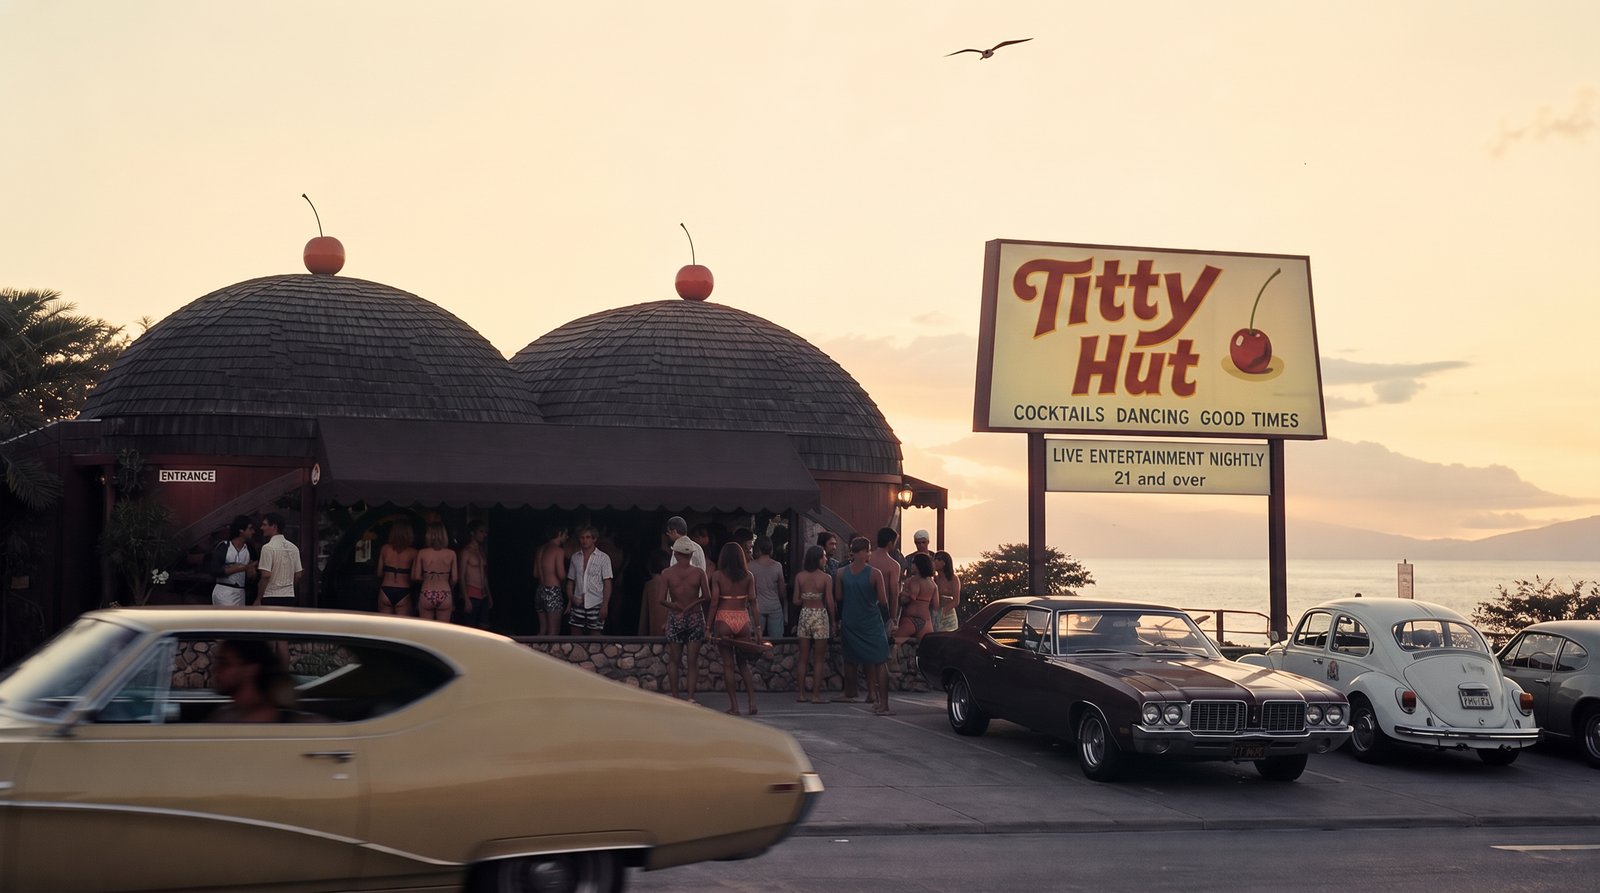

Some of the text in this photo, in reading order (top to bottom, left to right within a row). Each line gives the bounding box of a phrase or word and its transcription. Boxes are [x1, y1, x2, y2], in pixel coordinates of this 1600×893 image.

[1013, 256, 1224, 348] Titty
[1071, 334, 1200, 398] Hut
[1014, 405, 1299, 428] COCKTAILS DANCING GOOD TIMES
[1053, 448, 1264, 467] LIVE ENTERTAINMENT NIGHTLY
[161, 471, 214, 481] ENTRANCE
[1114, 471, 1206, 487] 21 and over
